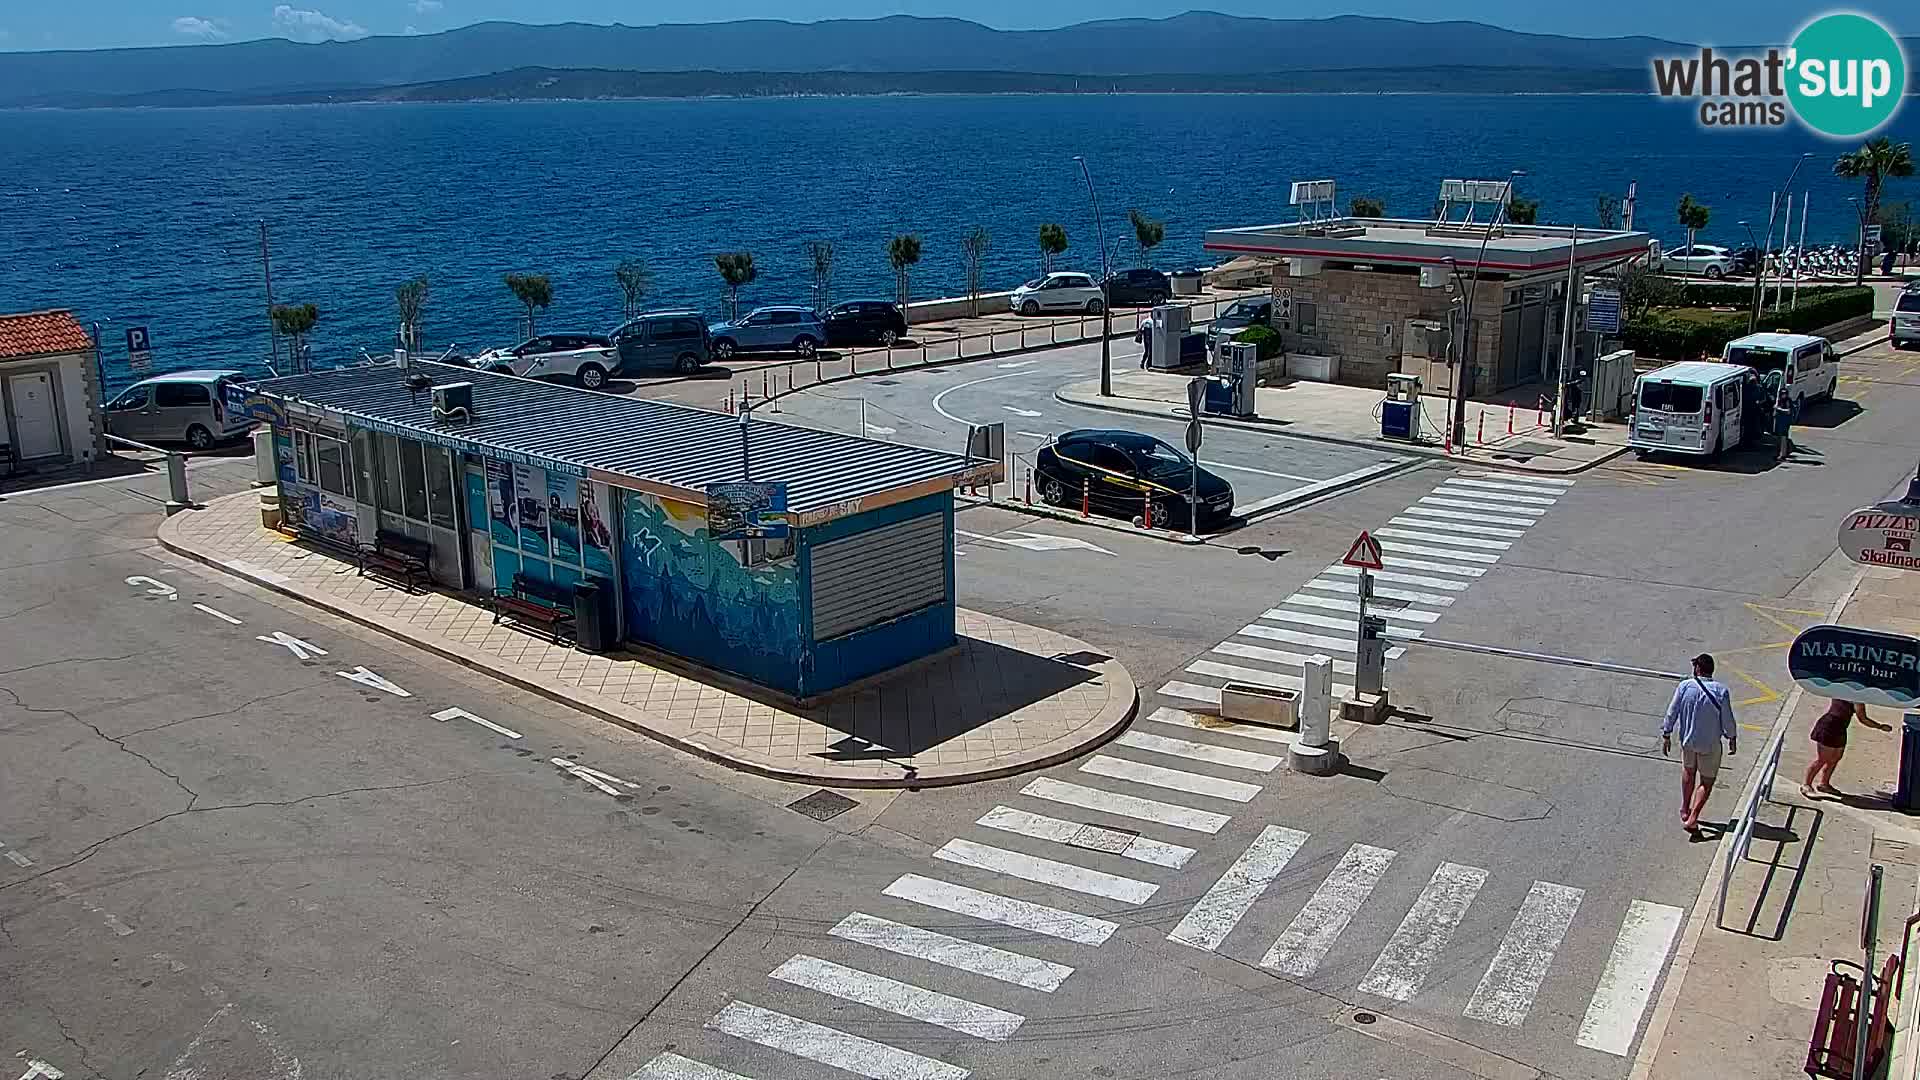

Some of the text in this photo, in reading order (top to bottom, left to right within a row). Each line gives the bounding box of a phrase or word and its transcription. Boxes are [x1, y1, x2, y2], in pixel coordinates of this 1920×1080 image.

[130, 330, 144, 349] P
[438, 437, 468, 450] POSTAJA
[479, 445, 494, 457] BUS
[495, 448, 527, 465] STATION
[529, 456, 555, 471] TICKET
[556, 462, 584, 477] OFFICE
[1882, 529, 1917, 540] GRILL
[1829, 661, 1897, 679] caffe bar
